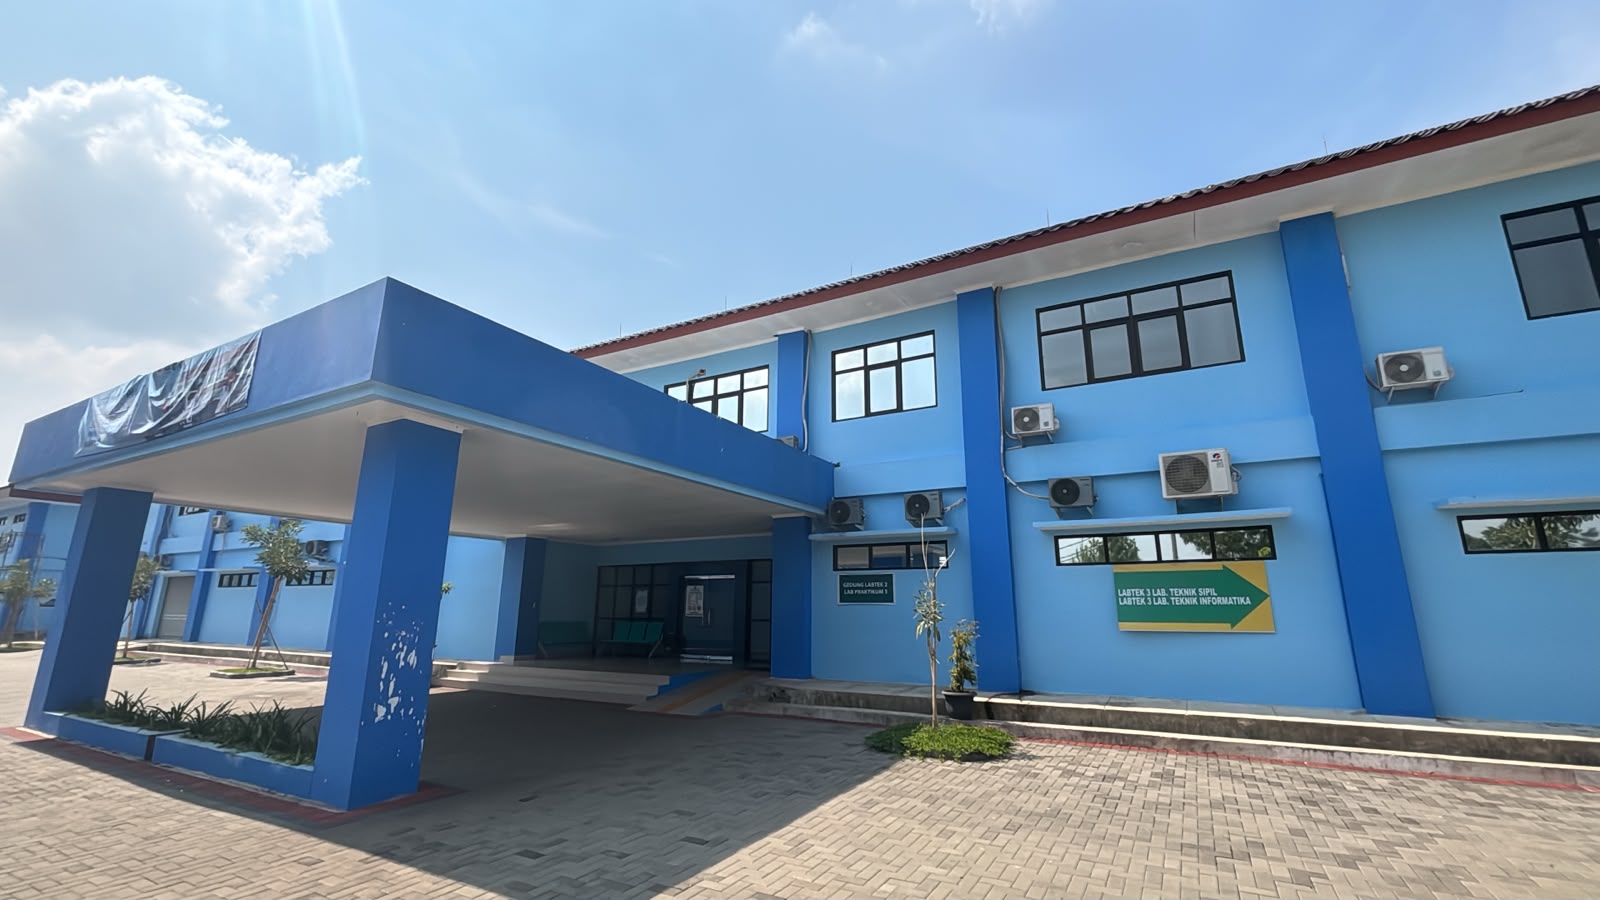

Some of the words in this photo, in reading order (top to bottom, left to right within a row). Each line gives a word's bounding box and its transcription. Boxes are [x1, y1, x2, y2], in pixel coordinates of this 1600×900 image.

[1118, 588, 1145, 596] LABTEK
[1146, 588, 1151, 596] 3
[1152, 588, 1168, 596] LAB.
[1169, 588, 1197, 596] TEKNIK
[1198, 588, 1217, 596] SIPIL
[1119, 597, 1145, 605] LABTEK
[1147, 597, 1152, 605] 3
[1153, 597, 1169, 605] LAB.
[1170, 597, 1198, 605] TEKNIK
[1199, 596, 1251, 605] INFORMATIKA
